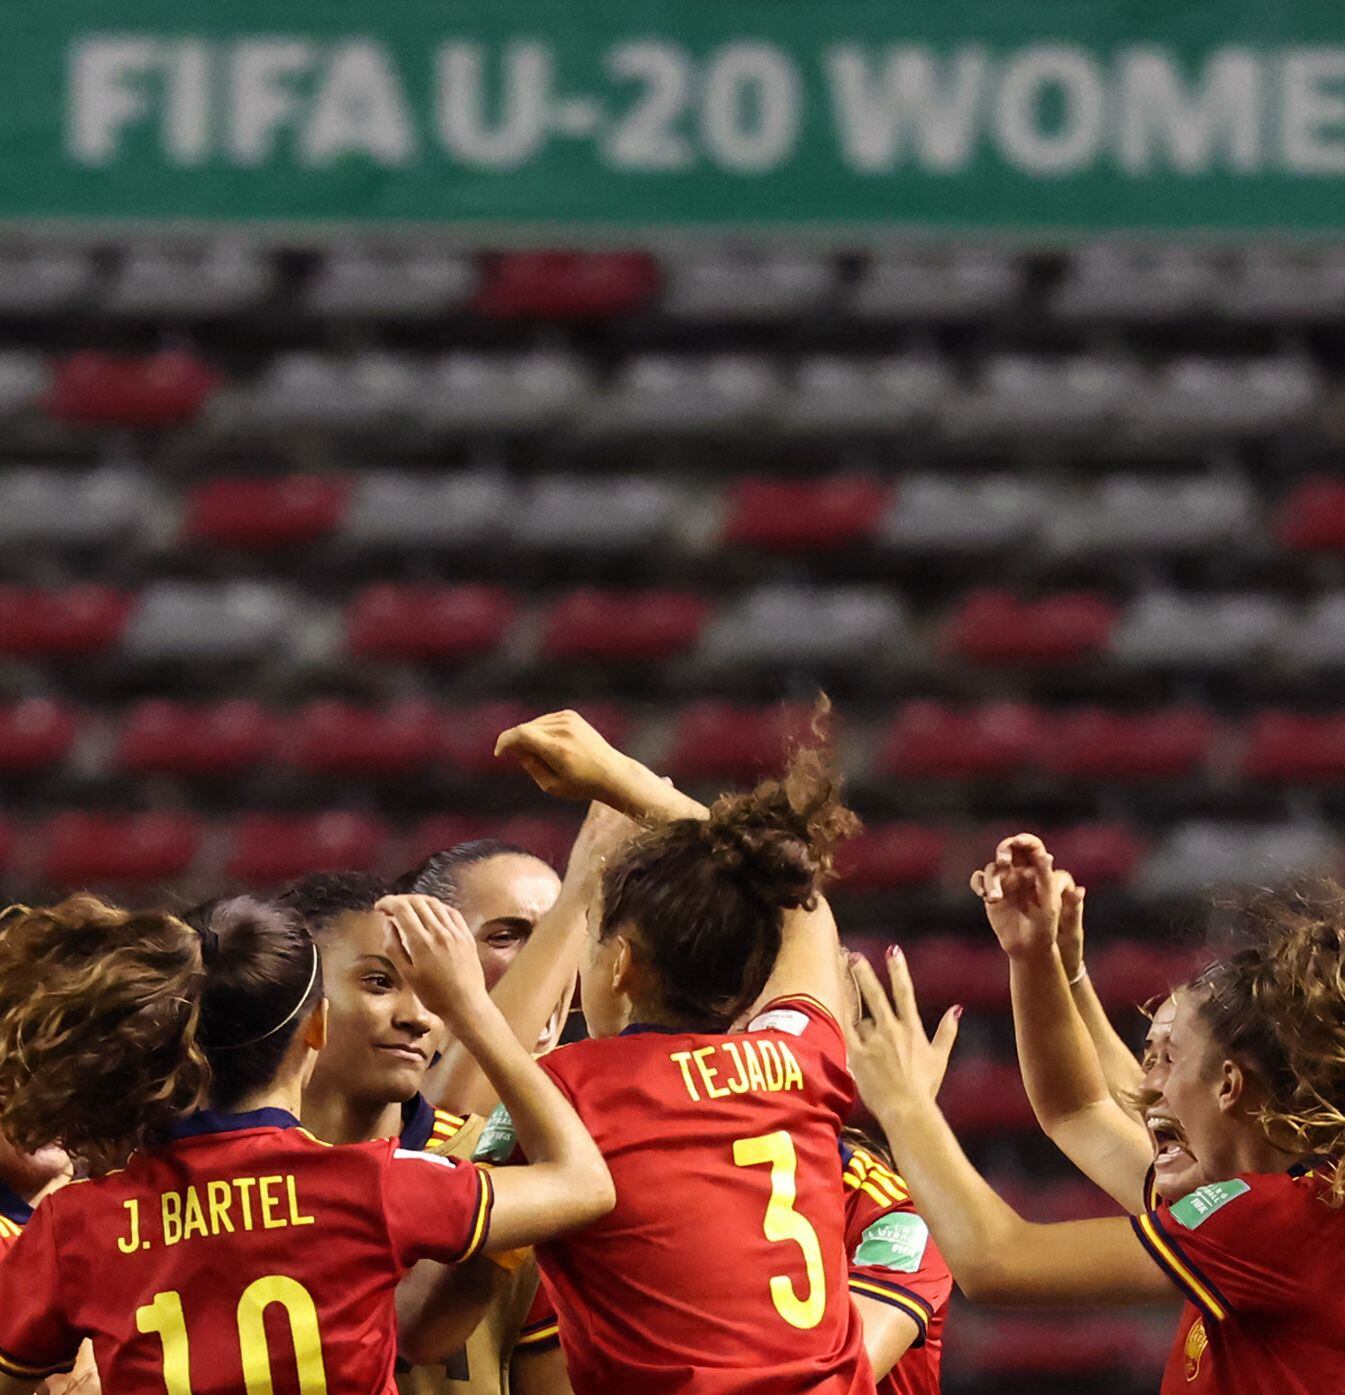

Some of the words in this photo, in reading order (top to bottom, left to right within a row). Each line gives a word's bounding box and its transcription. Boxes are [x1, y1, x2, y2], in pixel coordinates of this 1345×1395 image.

[67, 34, 416, 170] FIFA
[432, 38, 802, 173] U-20
[670, 1040, 804, 1101] TEJADA
[117, 1199, 150, 1254] J.
[161, 1174, 316, 1246] BARTEL
[732, 1130, 827, 1330] 3
